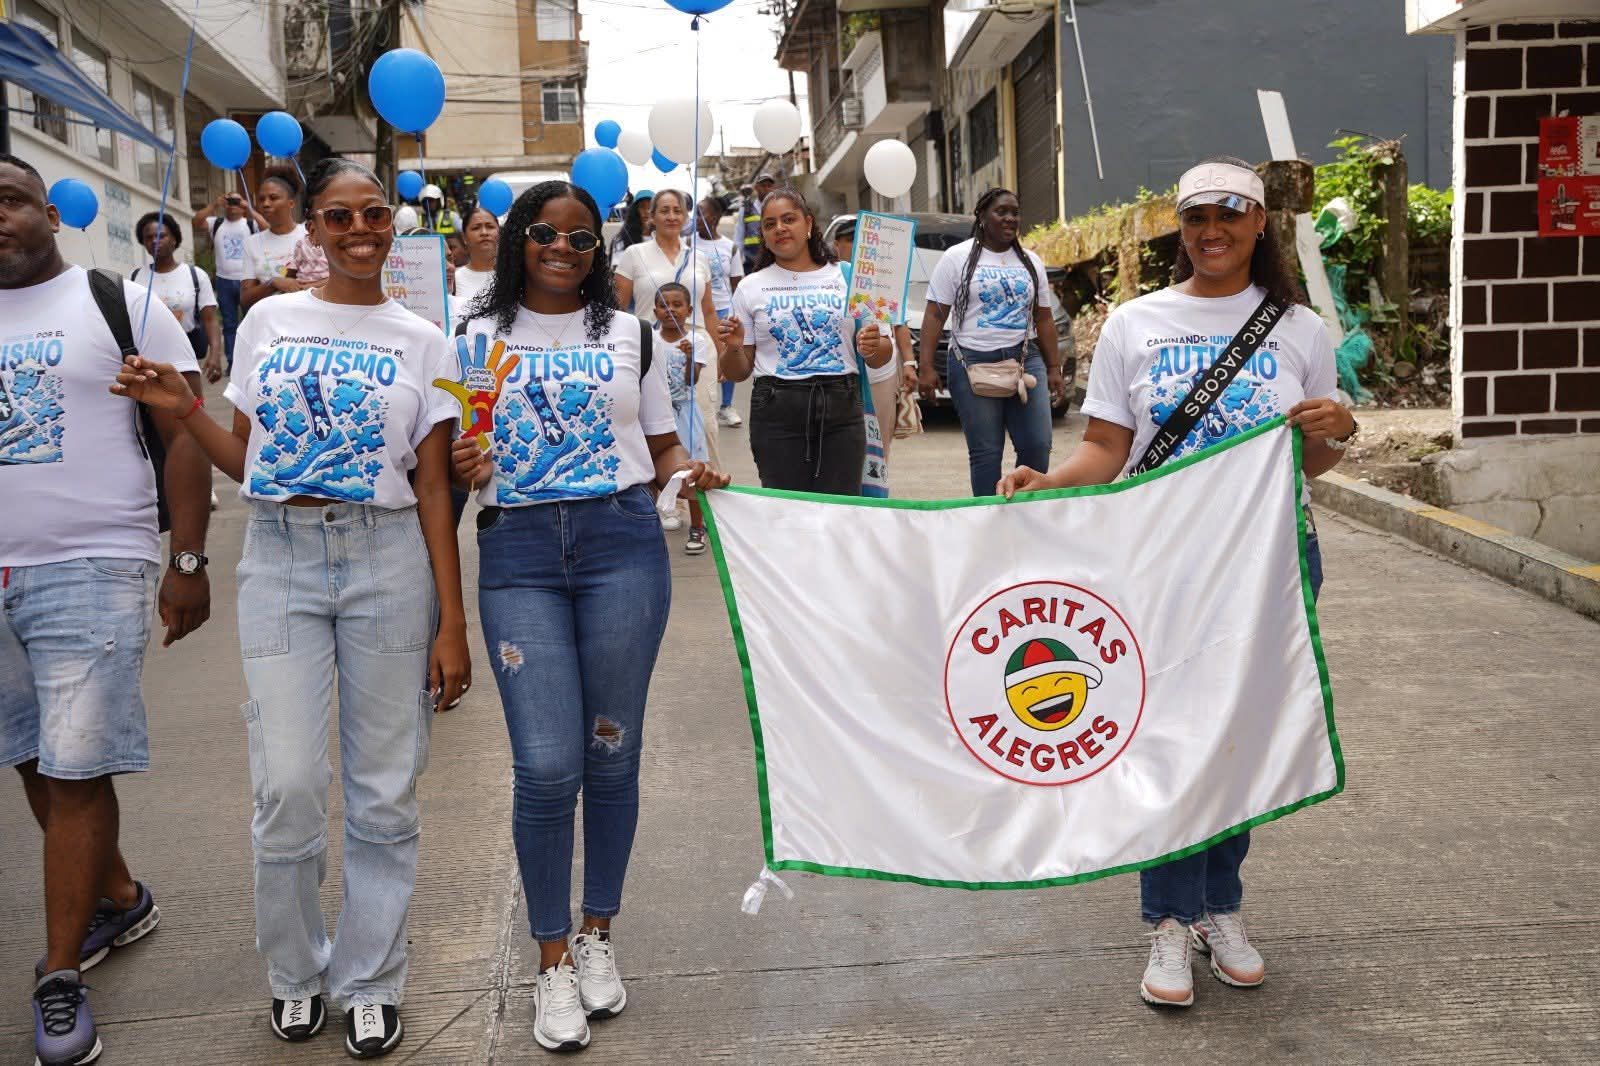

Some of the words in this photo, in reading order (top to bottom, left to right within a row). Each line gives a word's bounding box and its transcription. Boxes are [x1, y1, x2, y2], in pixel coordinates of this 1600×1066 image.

[862, 230, 880, 246] TEA
[859, 245, 877, 261] TEA
[383, 270, 406, 284] TEA
[857, 260, 875, 276] TEA
[386, 285, 408, 299] TEA
[769, 294, 842, 311] AUTISMO
[1242, 303, 1280, 345] MARC
[0, 339, 64, 371] ISMO
[270, 335, 330, 348] CAMINANDO
[330, 338, 369, 350] JUNTOS
[370, 344, 392, 354] POR
[393, 349, 405, 361] EL
[506, 344, 544, 353] NANDO
[607, 343, 617, 352] EL
[1147, 334, 1208, 348] CAMINANDO
[1268, 341, 1280, 351] EL
[266, 346, 398, 387] AUTISMO
[506, 351, 614, 383] UTISMO
[1184, 346, 1243, 417] JACOBS
[1147, 431, 1179, 465] THE
[971, 597, 1127, 665] CARITAS
[969, 714, 1119, 773] ALEGRES
